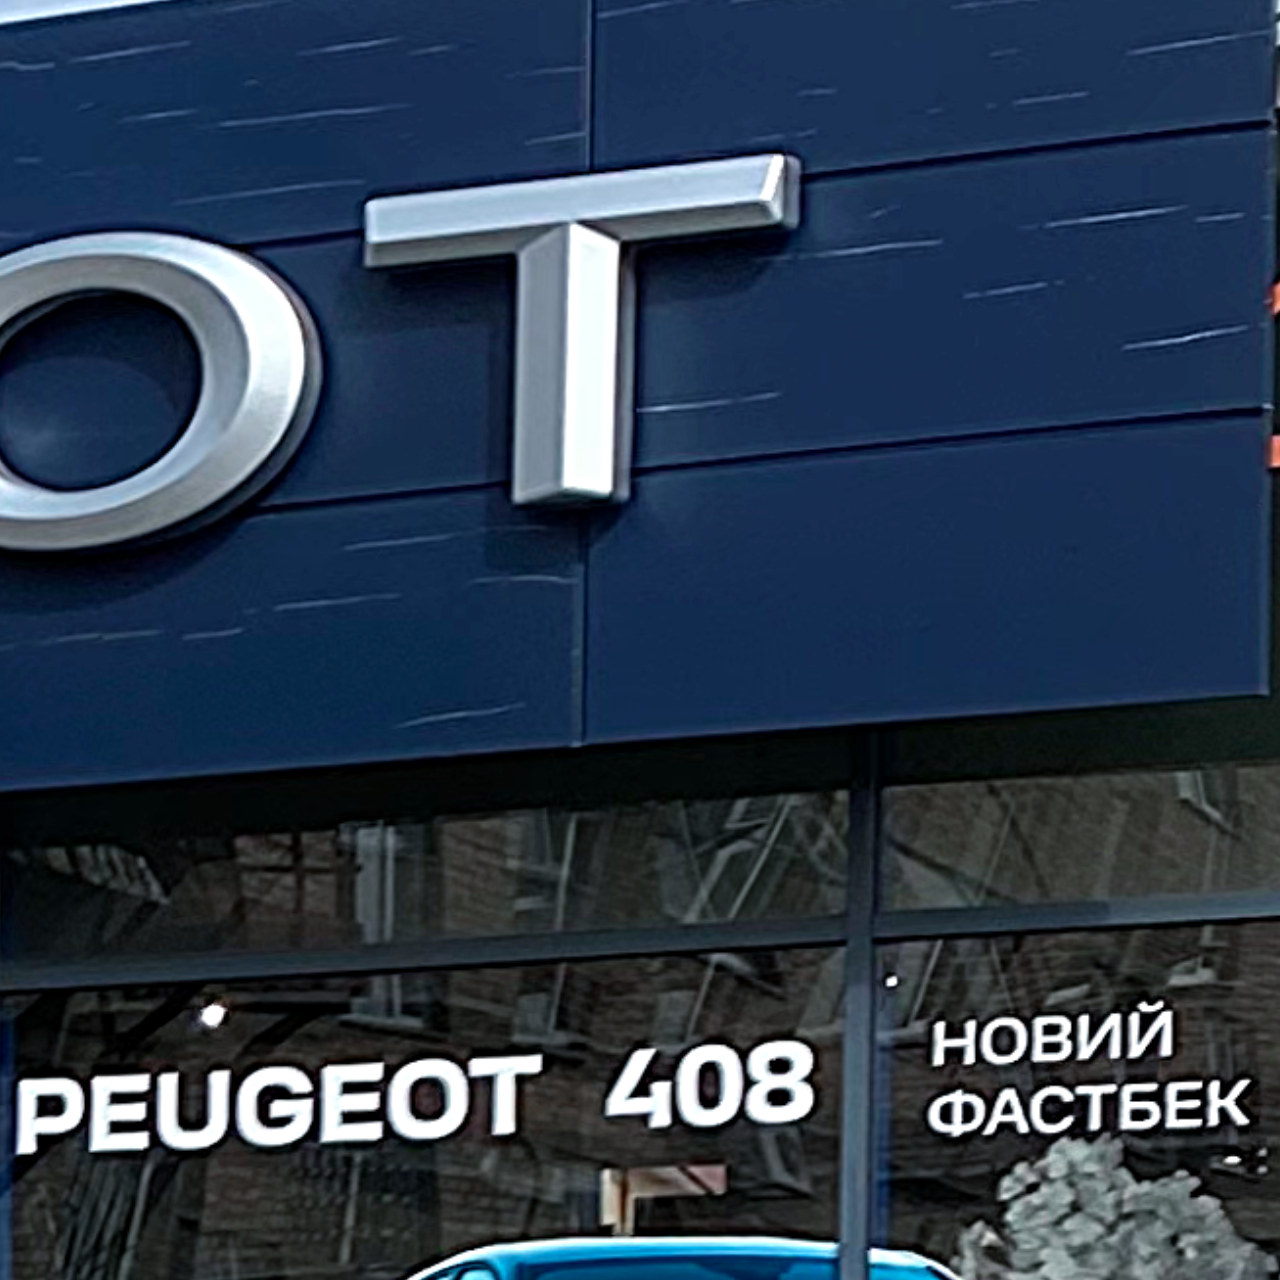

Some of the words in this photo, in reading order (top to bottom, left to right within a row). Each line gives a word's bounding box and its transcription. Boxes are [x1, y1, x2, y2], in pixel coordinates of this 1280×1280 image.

[931, 1000, 1173, 1067] НОВИЙ
[15, 1053, 543, 1155] PEUGEOT
[605, 1039, 815, 1129] 408
[927, 1078, 1250, 1137] ФАСТБЕК
